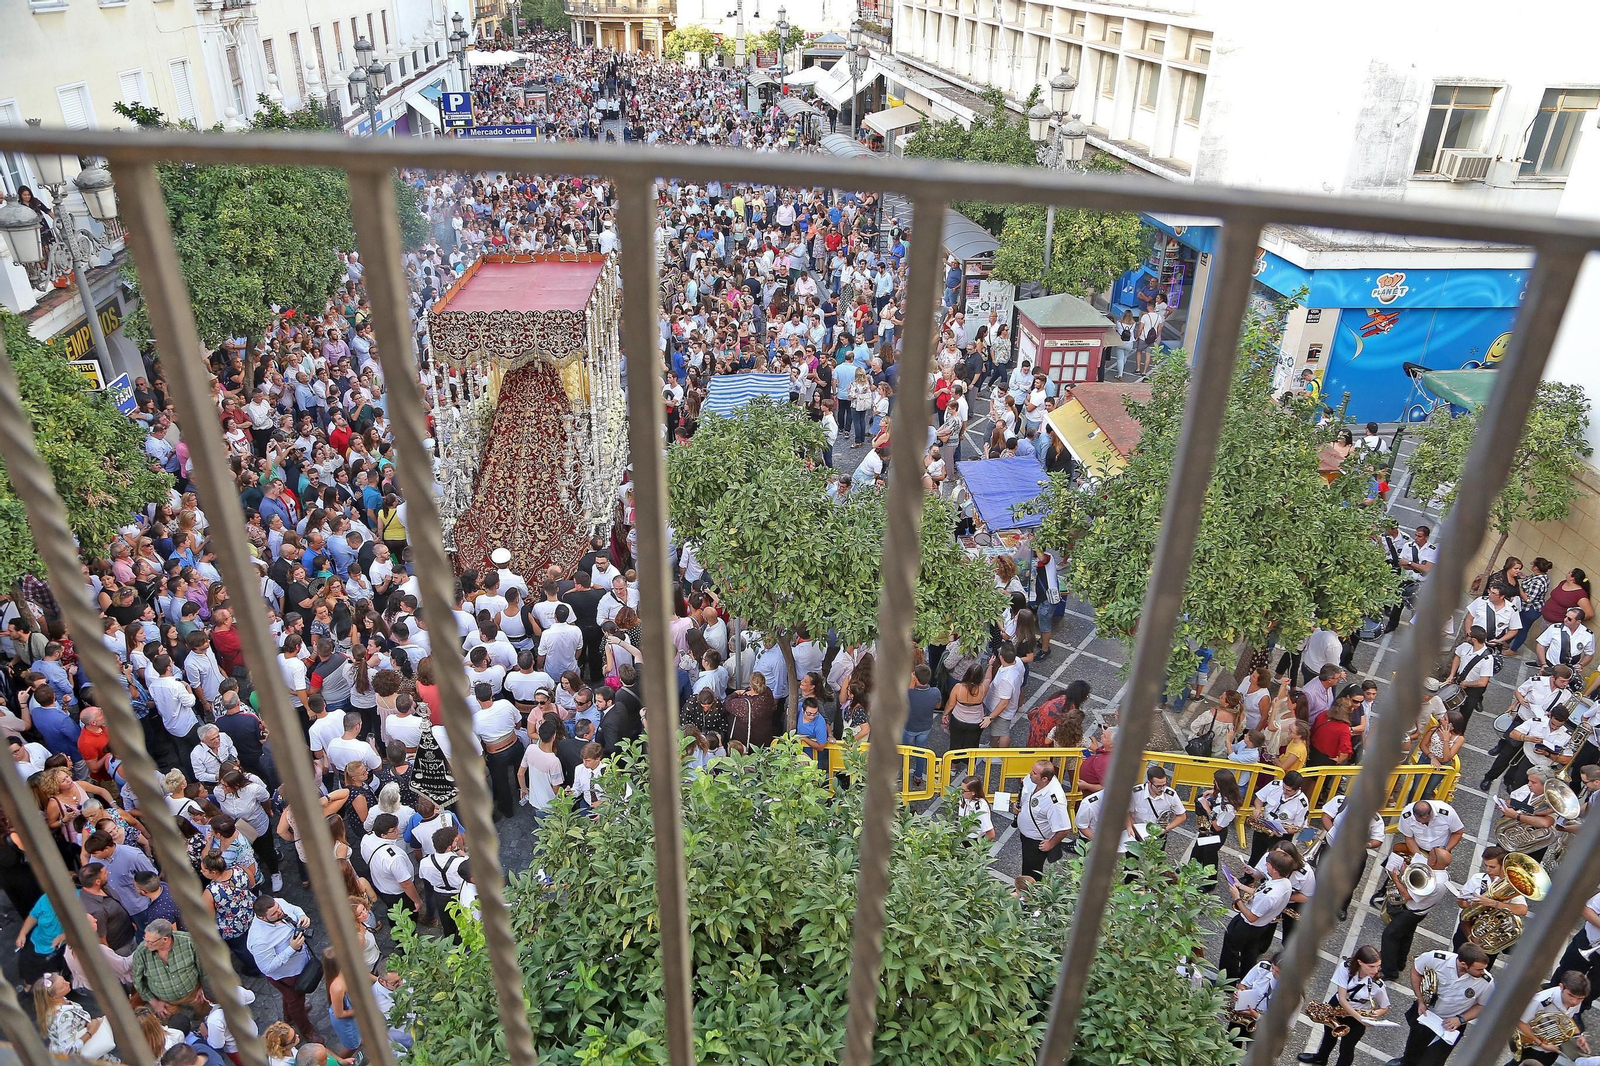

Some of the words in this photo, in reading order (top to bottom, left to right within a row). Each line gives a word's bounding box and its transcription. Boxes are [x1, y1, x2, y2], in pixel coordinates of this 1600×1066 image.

[449, 94, 464, 111] P
[457, 128, 465, 138] P
[64, 306, 118, 360] EMPOS
